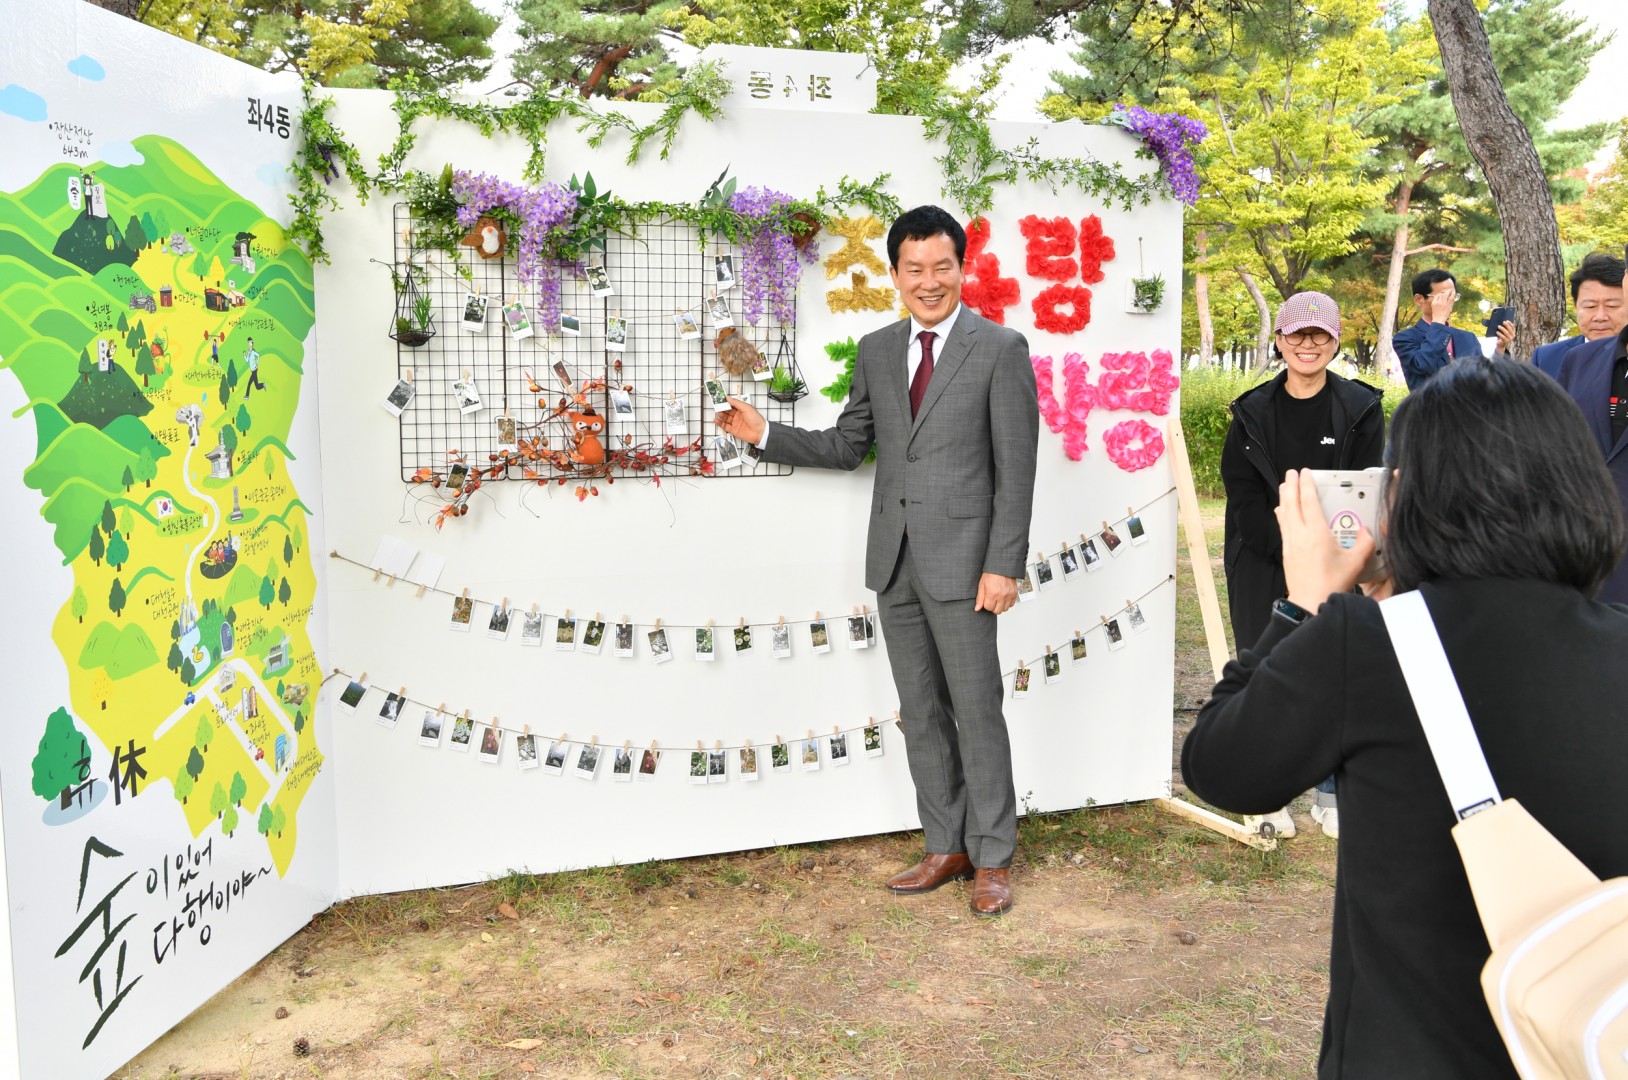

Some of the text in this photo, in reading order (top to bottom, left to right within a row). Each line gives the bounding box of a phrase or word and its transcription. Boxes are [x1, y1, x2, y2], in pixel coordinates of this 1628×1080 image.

[247, 96, 291, 140] 좌4동
[62, 144, 89, 158] 643m
[108, 738, 148, 806] 休
